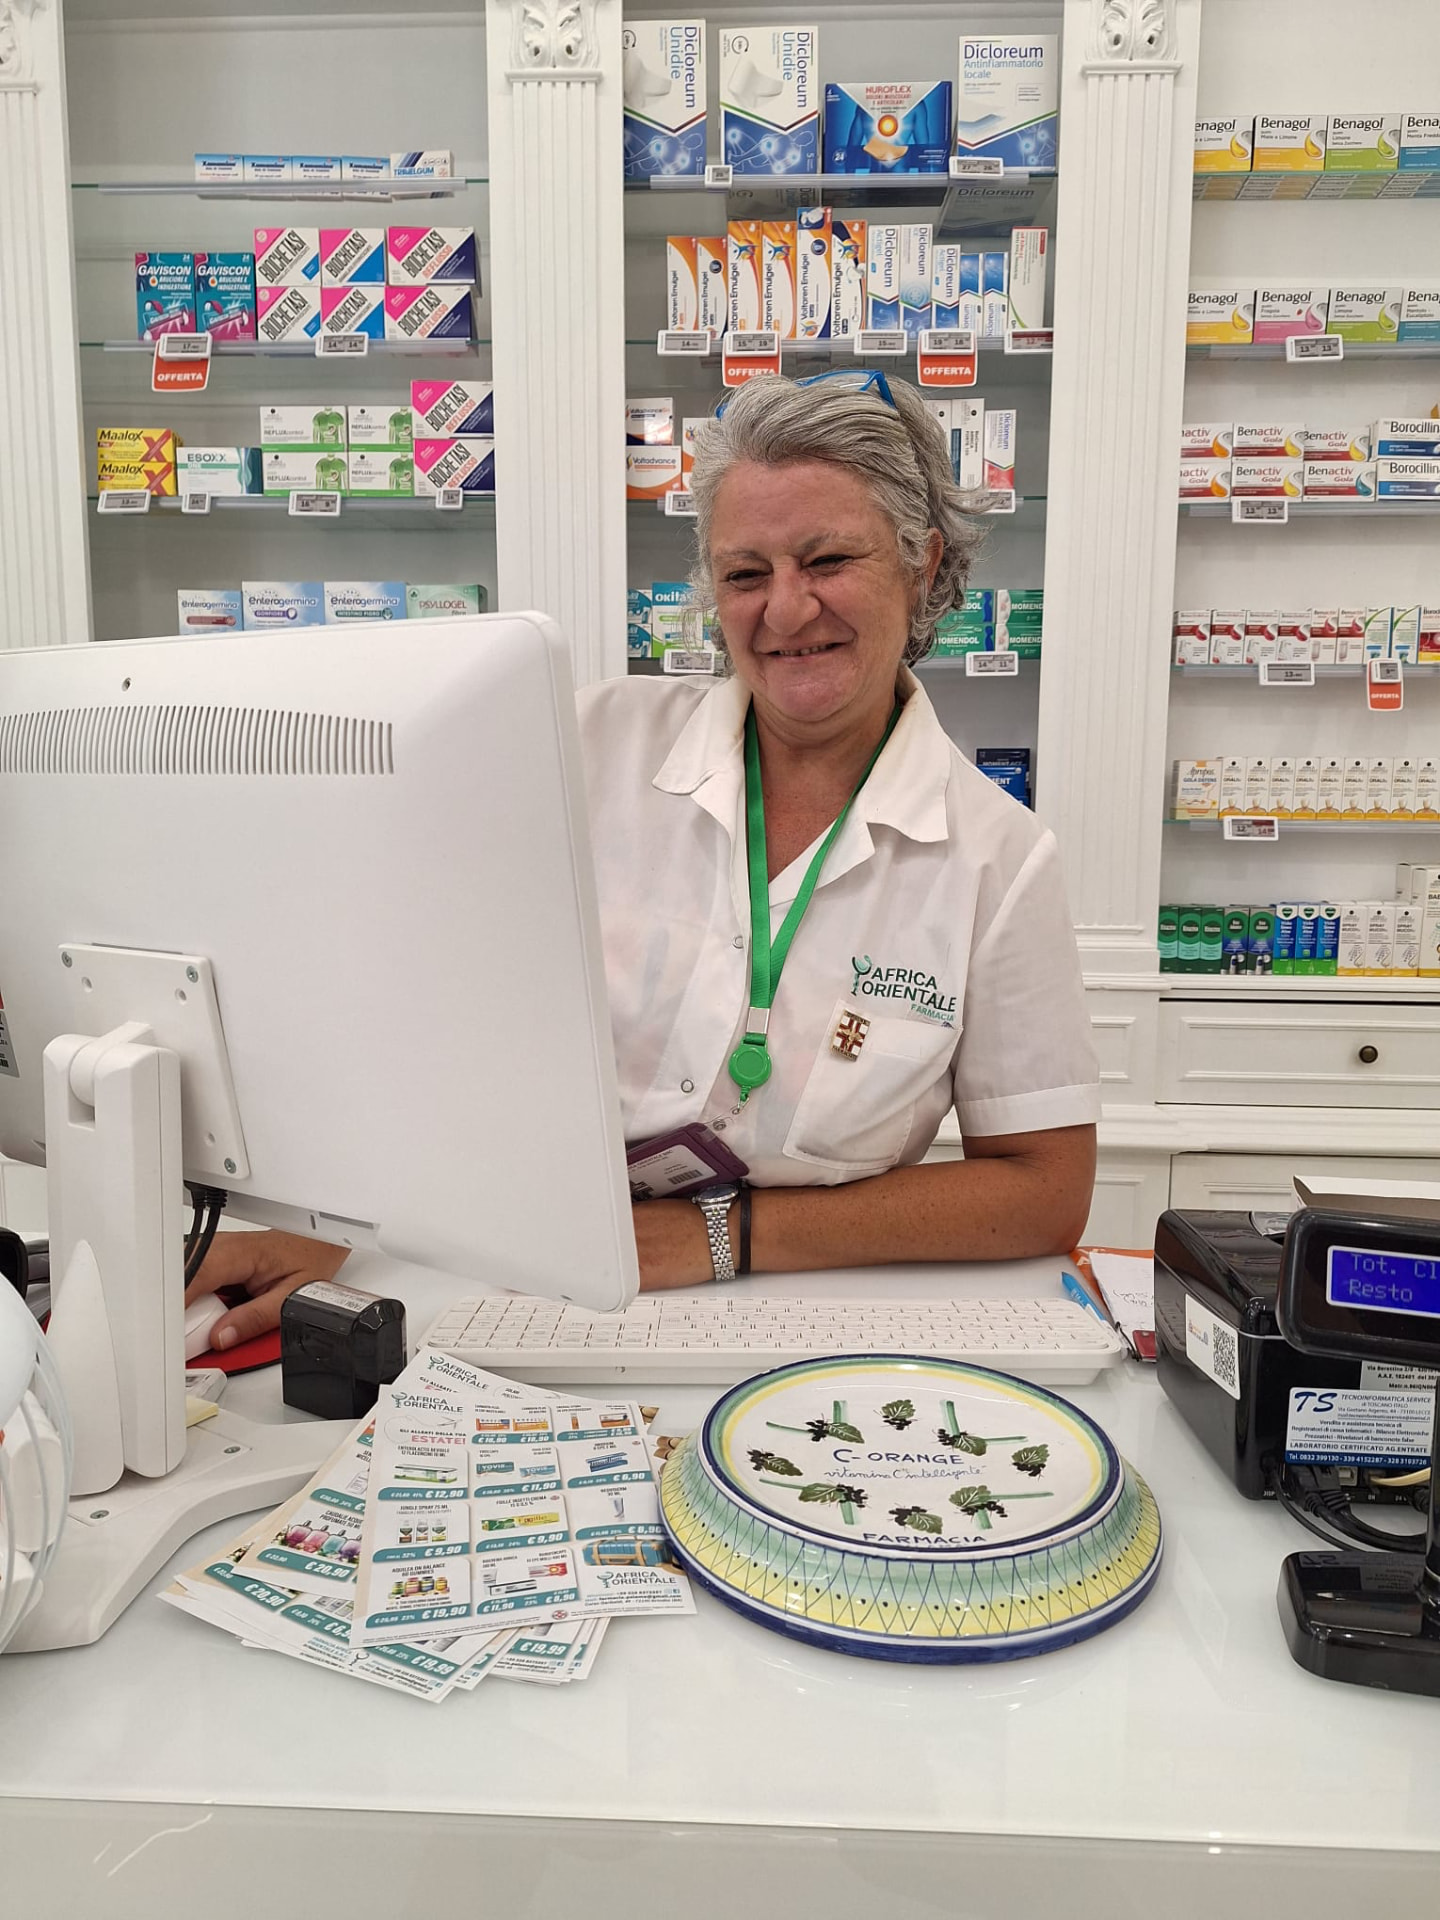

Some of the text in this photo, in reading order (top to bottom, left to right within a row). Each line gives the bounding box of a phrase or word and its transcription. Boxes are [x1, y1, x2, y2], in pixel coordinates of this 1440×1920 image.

[670, 26, 683, 79] Unidie
[782, 32, 795, 81] Unidie
[964, 44, 1043, 59] Dicloreum
[684, 26, 697, 108] Dicloreum
[797, 32, 810, 108] Dicloreum
[964, 59, 1044, 69] Antinfiammatorio
[964, 69, 991, 79] locale
[865, 85, 912, 94] NUROFLEX
[1195, 119, 1236, 133] enagol
[1260, 117, 1311, 131] Benagol
[1332, 117, 1384, 131] Benagol
[1407, 116, 1440, 129] Bena
[258, 229, 307, 284] BIOCHETASI
[324, 230, 368, 279] BIOCHETASI
[401, 229, 447, 279] BIOCHETASI
[884, 228, 896, 288] Dicloreum
[918, 227, 928, 276] Dicloreum
[421, 244, 454, 280] REFLUSSO
[138, 265, 192, 276] GAVISCON
[197, 265, 251, 276] GAVISCON
[945, 247, 955, 298] Dicloreum
[800, 253, 812, 320] Voltaren Emulgel
[832, 262, 843, 337] Voltaren Emulgel
[1187, 292, 1238, 306] Benagol
[1261, 291, 1312, 304] Benagol
[1335, 291, 1386, 304] Benagol
[1407, 291, 1440, 303] Bena
[260, 288, 309, 341] BIOCHETASI
[326, 288, 368, 333] BIOCHETASI
[397, 288, 443, 337] BIOCHETASI
[418, 303, 449, 337] REFLUSSO
[156, 372, 203, 382] OFFERTA
[728, 367, 775, 376] OFFERTA
[922, 366, 971, 376] OFFERTA
[425, 384, 470, 433] BIOCHETASI
[445, 399, 477, 432] REFLUSSO
[1237, 426, 1283, 436] Benactiv
[1390, 421, 1440, 433] Borocillin
[99, 430, 144, 441] Maalox
[1303, 431, 1349, 441] Benactiv
[187, 453, 227, 462] ESOXX
[632, 457, 676, 465] Voltadvance
[100, 463, 145, 475] Maalox
[427, 442, 472, 488] BIOCHETASI
[1236, 466, 1282, 476] Benactiv
[1308, 465, 1354, 476] Benactiv
[1389, 462, 1440, 474] Borocillin
[447, 456, 478, 489] REFLUSSO
[181, 599, 239, 610] enterogermina
[248, 595, 318, 608] enterogermina
[330, 595, 399, 608] enterogermina
[419, 599, 467, 610] PSYLLOGEL
[871, 967, 938, 990] AFRICA
[861, 980, 957, 1012] ORIENTALE
[910, 1003, 955, 1022] FARMACIA
[1351, 1253, 1396, 1276] Tot.
[1349, 1278, 1413, 1303] Resto
[442, 1361, 478, 1380] AFRICA
[436, 1365, 489, 1391] ORIENTALE
[406, 1395, 448, 1405] AFRICA
[1294, 1391, 1338, 1413] TS
[1341, 1394, 1431, 1403] TECNOINFORMATICA SERVICE
[403, 1400, 464, 1413] ORIENTALE
[411, 1434, 466, 1445] ESTATE!
[1290, 1442, 1339, 1450] LABORATORIO
[1340, 1444, 1384, 1452] CERTIFICATO
[863, 1533, 987, 1544] FARMACIA
[611, 1577, 677, 1585] ORIENTALE
[615, 1571, 658, 1579] AFRICA
